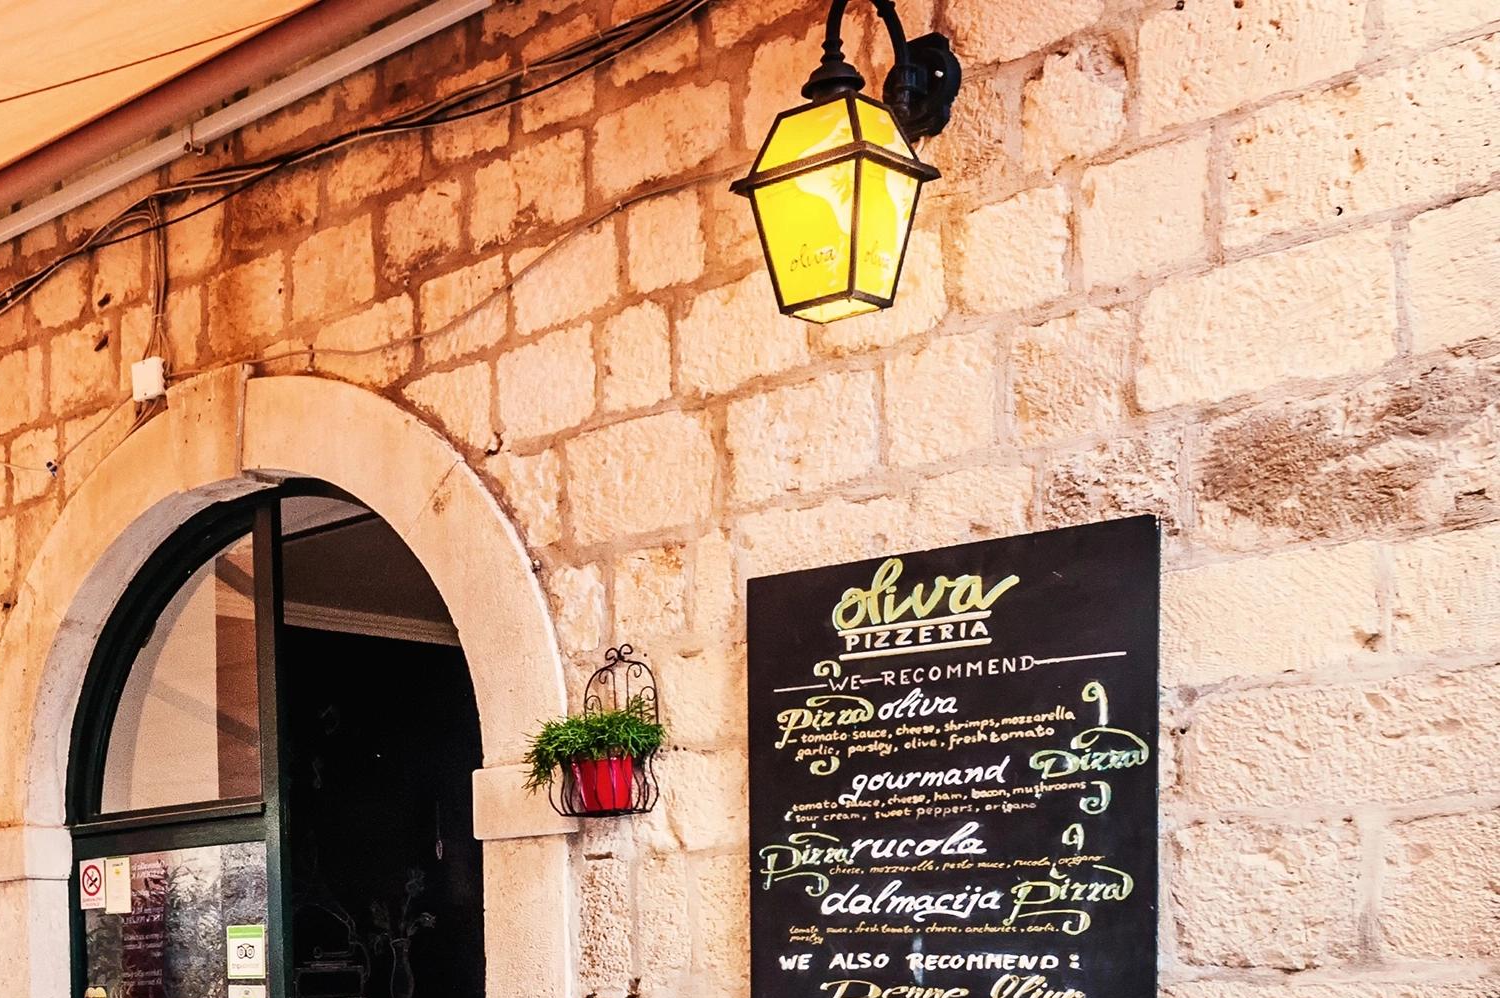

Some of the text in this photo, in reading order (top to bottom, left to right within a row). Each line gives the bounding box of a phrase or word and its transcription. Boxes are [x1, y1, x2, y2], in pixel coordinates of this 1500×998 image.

[789, 243, 837, 272] oliva
[833, 558, 1020, 631] oliva
[845, 622, 989, 652] PIZZERIA
[829, 655, 1036, 692] WE RECOMMEND
[775, 687, 959, 750] Pizza oliva
[801, 729, 848, 744] tomato
[852, 729, 893, 740] sauce,
[1001, 705, 1077, 726] mozzarella
[795, 745, 841, 761] garlic,
[948, 730, 988, 751] fresh
[989, 725, 1056, 743] tomato
[792, 799, 839, 812] tomato
[933, 791, 968, 801] ham,
[1012, 780, 1088, 795] mushrooms
[838, 755, 1011, 806] gourmand
[794, 814, 820, 823] sour
[874, 807, 913, 819] sweet
[850, 821, 988, 860] rucola
[820, 879, 1005, 923] dalmacija
[778, 953, 813, 971] WE
[828, 951, 891, 970] ALSO
